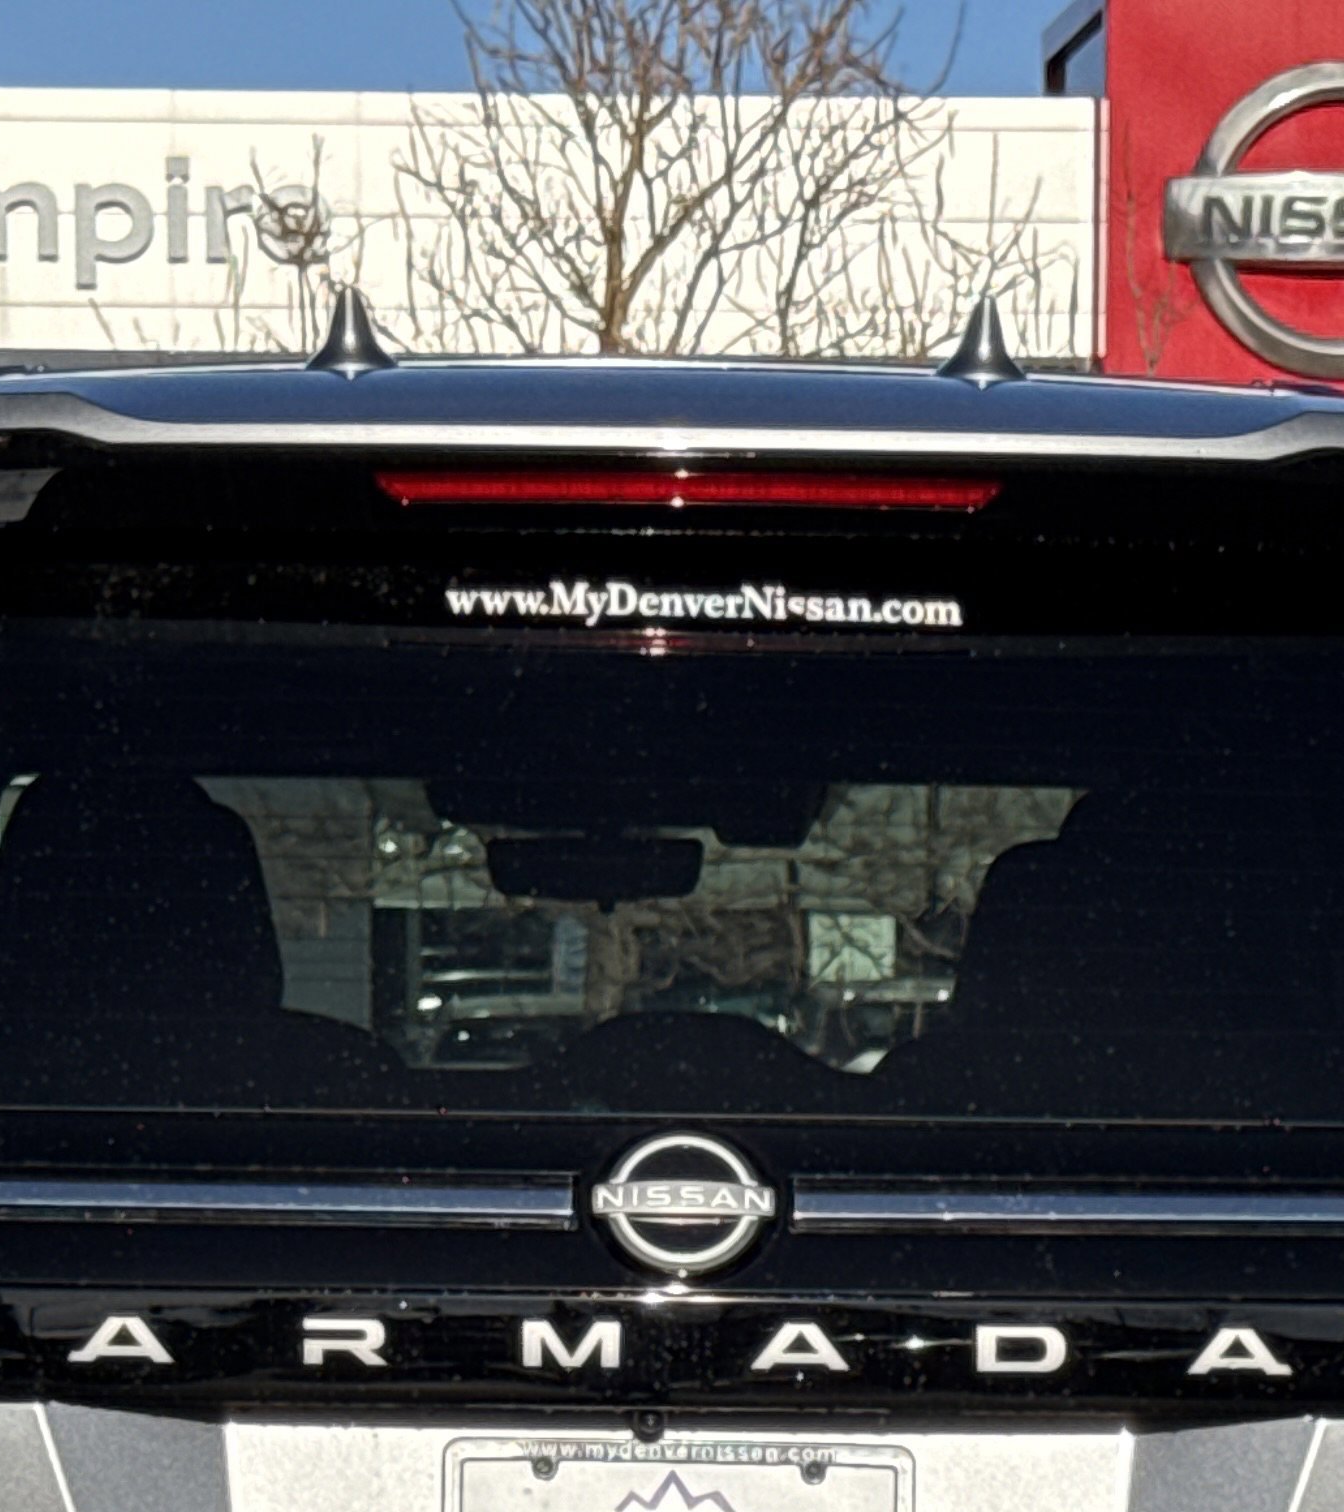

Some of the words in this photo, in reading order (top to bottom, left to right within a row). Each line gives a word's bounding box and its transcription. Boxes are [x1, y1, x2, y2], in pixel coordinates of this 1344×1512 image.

[445, 581, 963, 627] www.MyDenverNissan.com
[596, 1184, 772, 1212] NISSAN
[66, 1315, 1294, 1378] ARMADA
